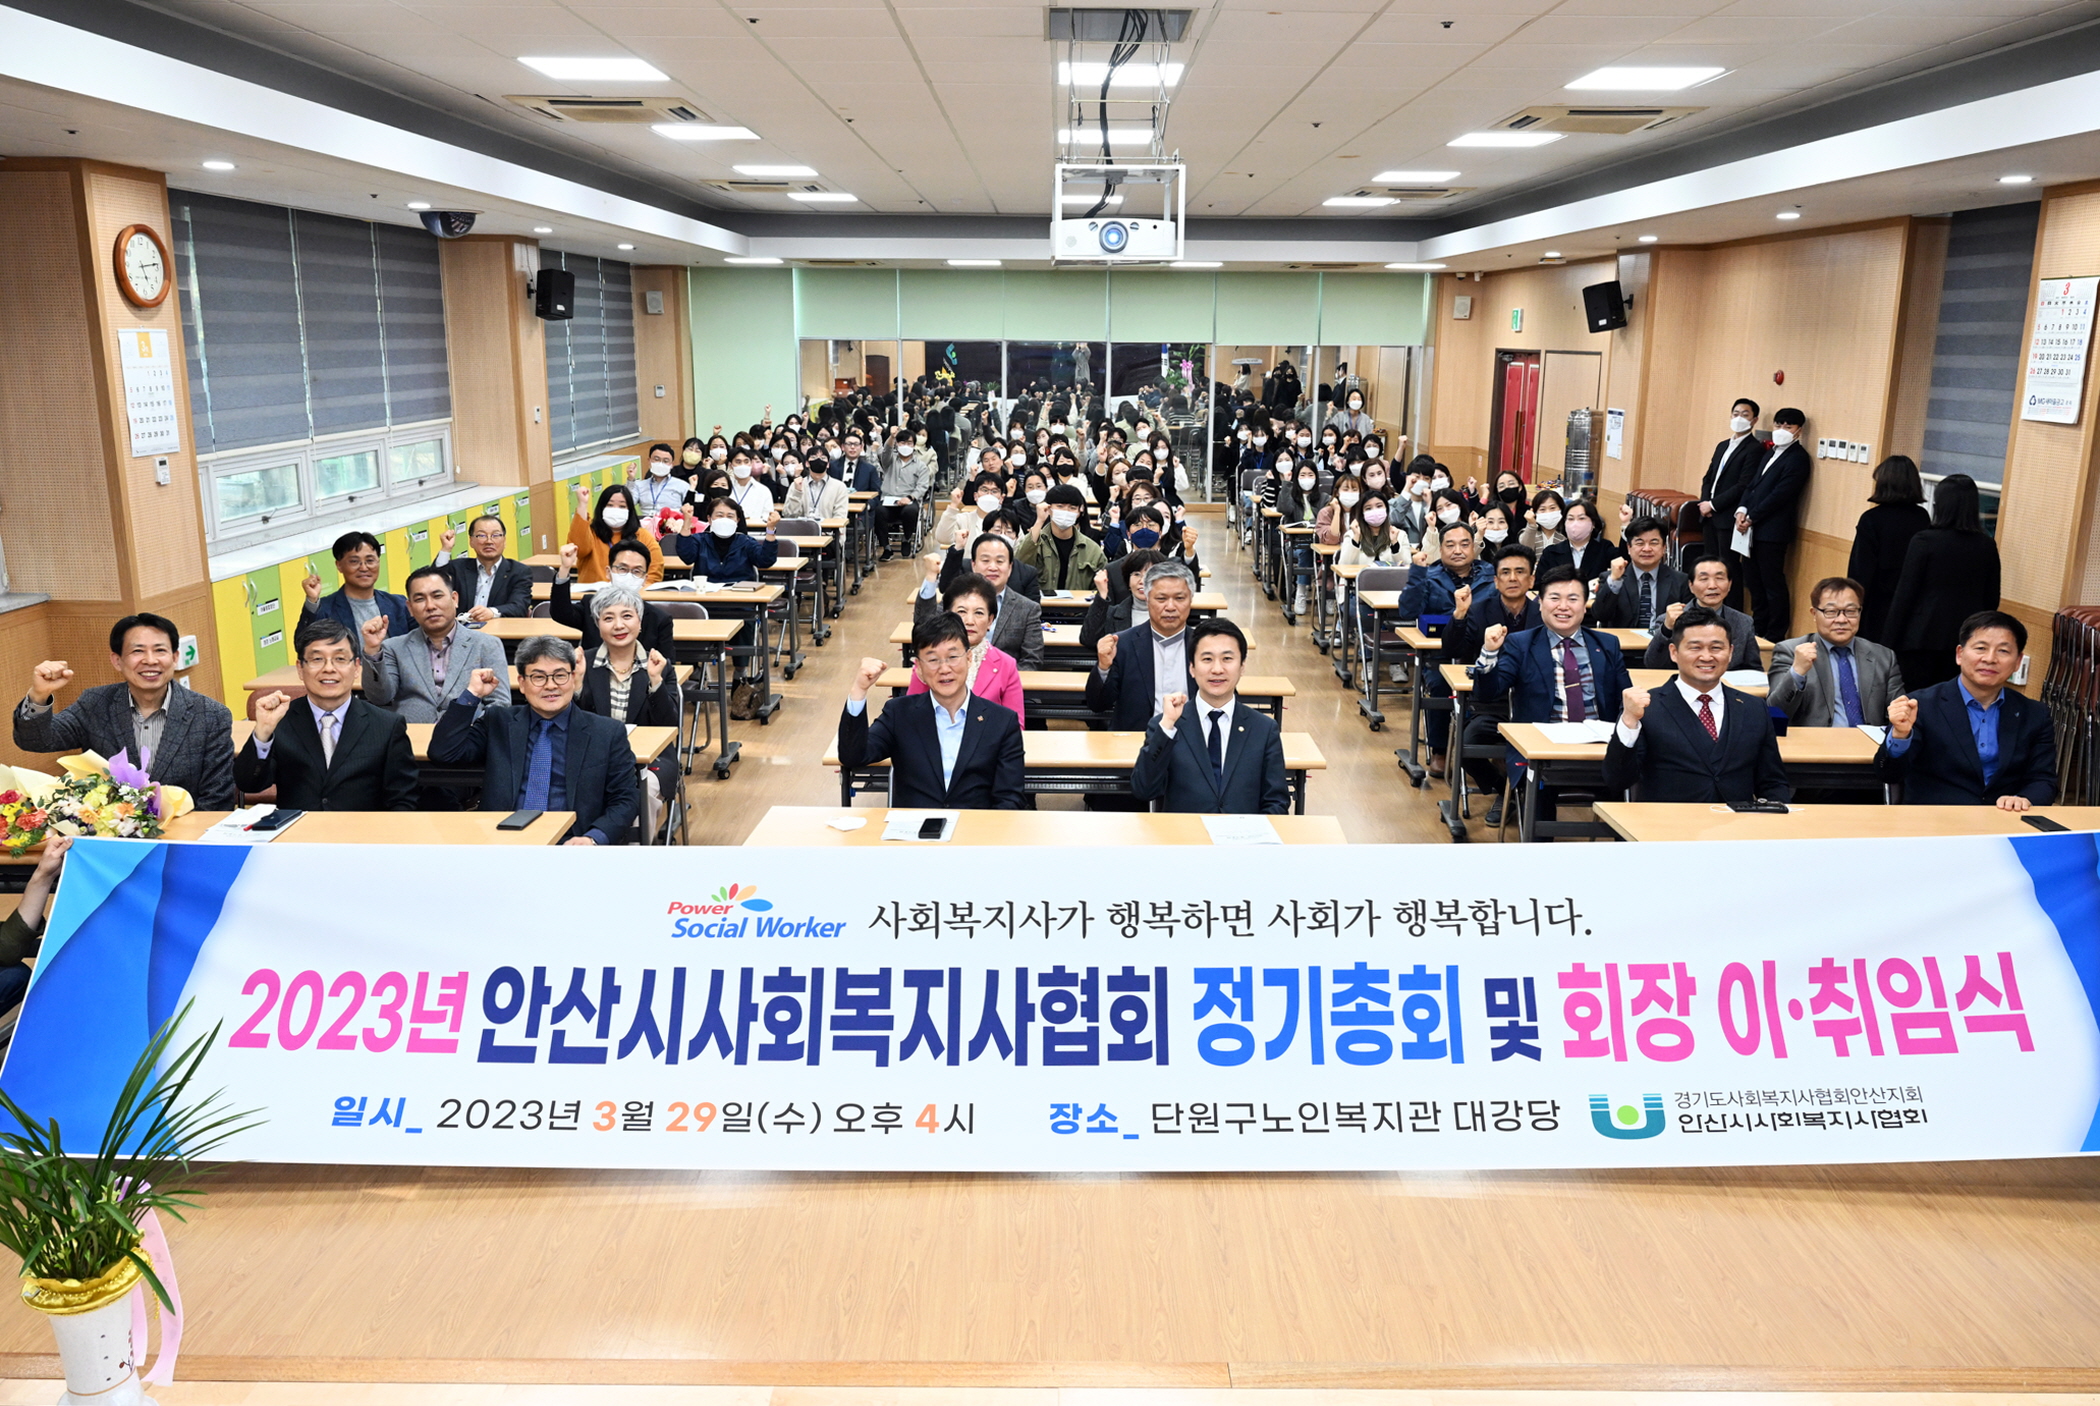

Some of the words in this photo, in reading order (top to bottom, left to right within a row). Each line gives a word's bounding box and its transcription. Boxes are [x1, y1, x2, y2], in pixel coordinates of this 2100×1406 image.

[2064, 282, 2070, 295] 3
[667, 901, 734, 915] Power
[868, 900, 1095, 940] 사회복지사가
[1106, 899, 1256, 939] 행복하면
[1267, 898, 1382, 939] 사회가
[1392, 897, 1593, 938] 행복합니다.
[671, 916, 749, 939] Social
[755, 915, 847, 939] Worker
[228, 968, 469, 1054] 2023년
[477, 965, 1170, 1067] 안산시사회복지사협회
[1193, 962, 1465, 1067] 정기총회
[1484, 976, 1542, 1062] 및
[1557, 961, 1697, 1063] 회장
[1674, 1086, 1923, 1109] 경기도사회복지사협회안산지회
[436, 1098, 581, 1131] 2023년
[593, 1100, 654, 1132] 3월
[665, 1101, 822, 1135] 29일(수)
[833, 1101, 903, 1135] 오후
[915, 1102, 974, 1135] 4시
[1152, 1101, 1442, 1135] 단원구노인복지관
[1453, 1099, 1561, 1132] 대강당
[1678, 1108, 1928, 1134] 안산시사회복지사협회
